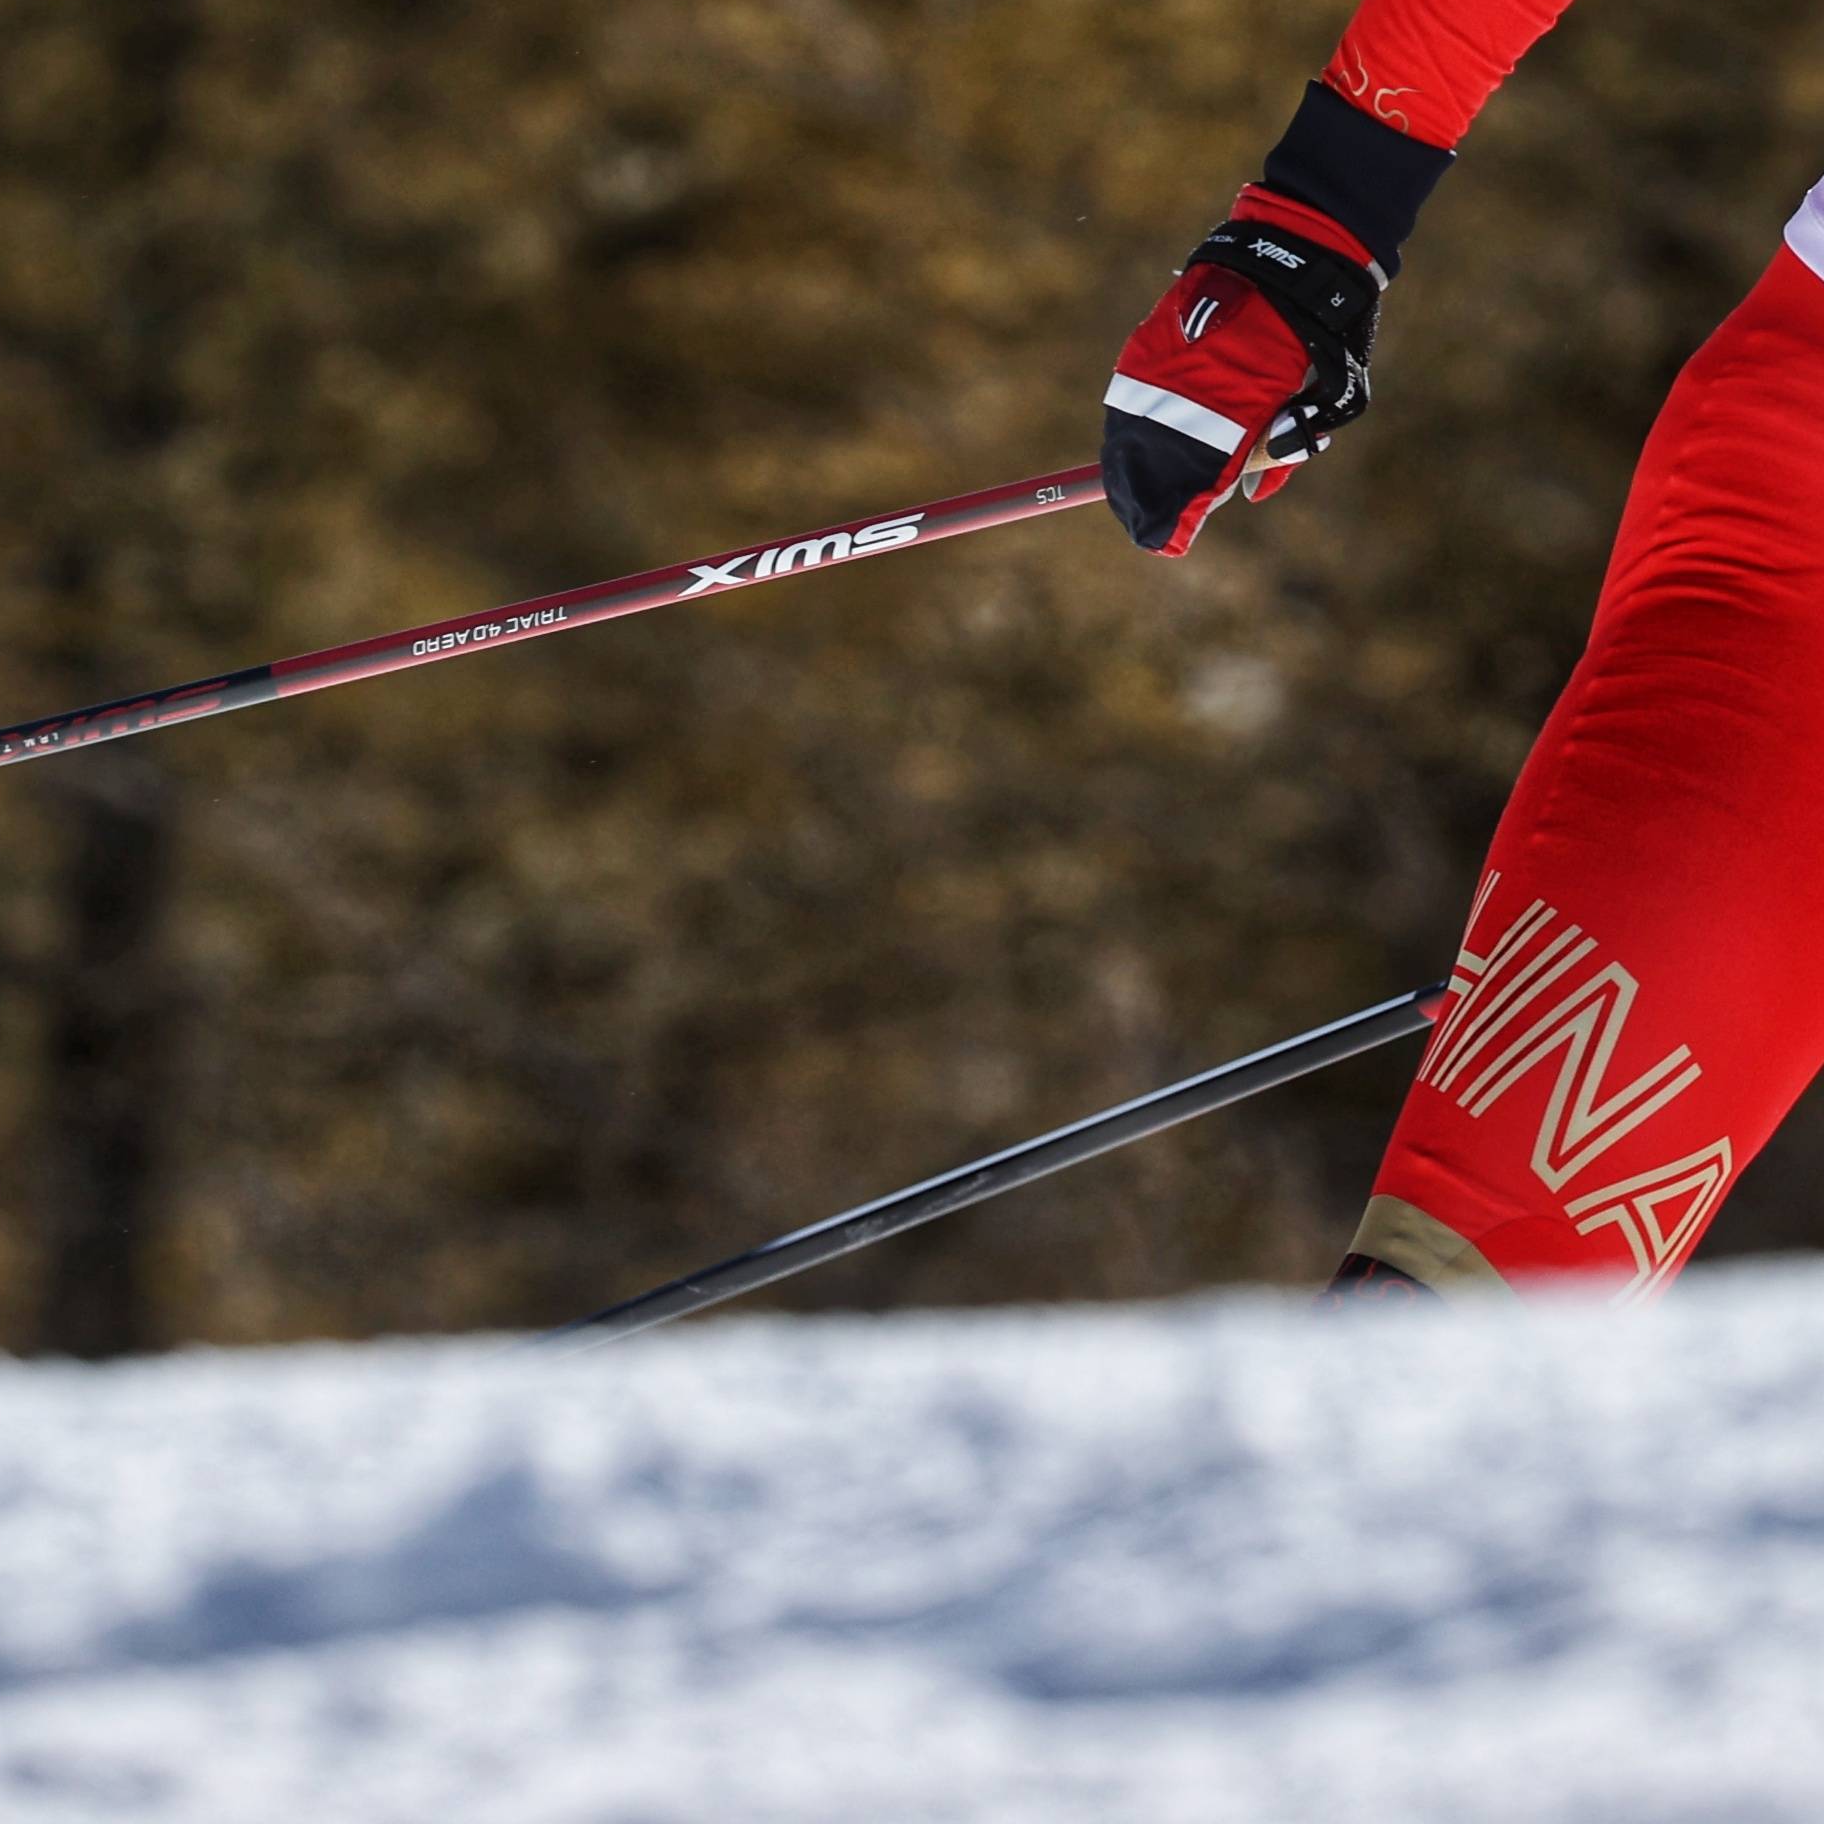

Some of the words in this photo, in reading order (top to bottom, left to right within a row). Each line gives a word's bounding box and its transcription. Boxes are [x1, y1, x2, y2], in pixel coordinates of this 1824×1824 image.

[1330, 291, 1346, 308] R
[1036, 484, 1067, 505] TCS
[504, 606, 569, 634] TRIAC
[412, 628, 471, 657] AERO
[1416, 869, 1733, 1311] HINA
